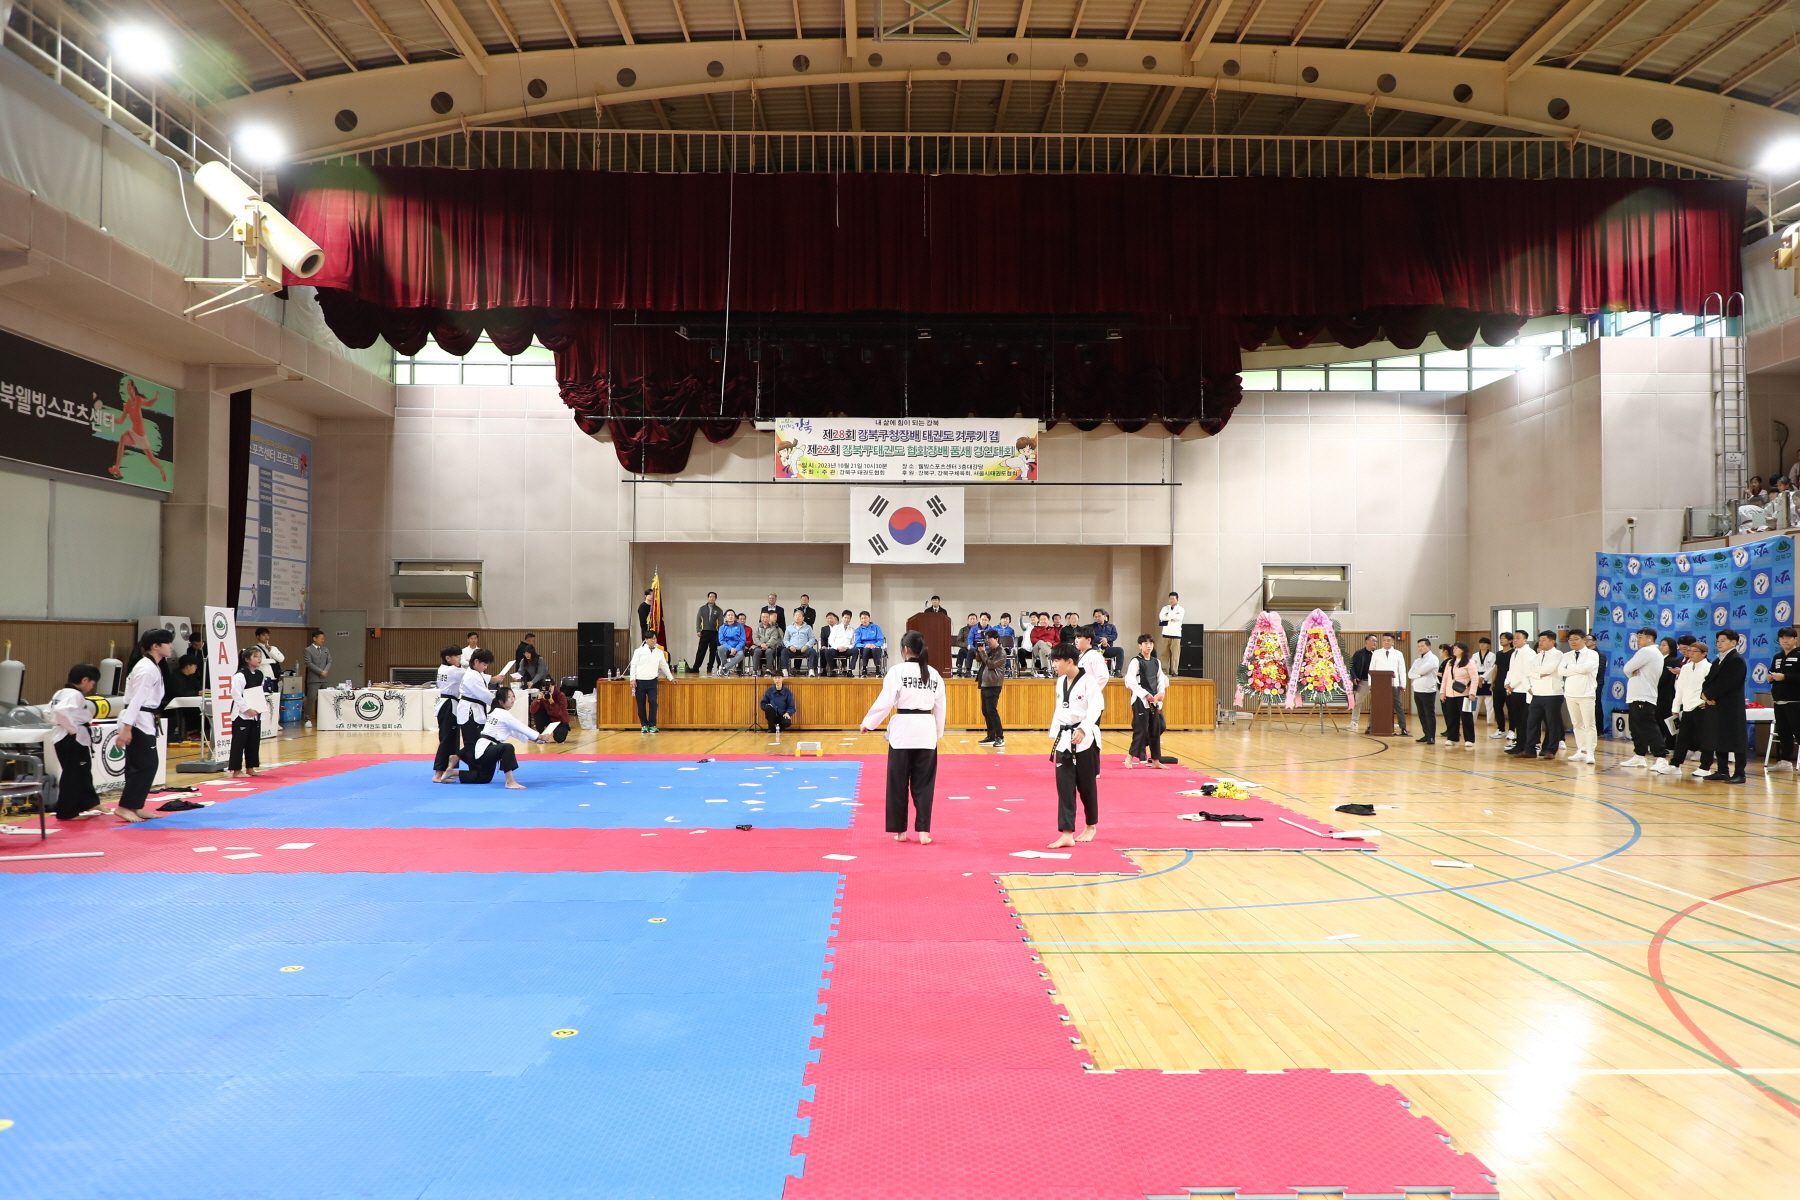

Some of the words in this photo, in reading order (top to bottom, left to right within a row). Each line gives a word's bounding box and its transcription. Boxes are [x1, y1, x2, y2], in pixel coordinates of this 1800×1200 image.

[822, 429, 856, 440] 제28회
[858, 429, 921, 442] 강북구청장배
[922, 430, 954, 443] 태권도
[955, 430, 988, 443] 겨루기
[989, 430, 1000, 443] 겸
[807, 444, 840, 456] 제22회
[842, 445, 905, 457] 강북구태권도
[907, 445, 949, 458] 협회장배
[950, 445, 972, 458] 품새
[973, 446, 1016, 458] 경연대회
[276, 451, 299, 470] 프로그램
[1753, 543, 1769, 557] KTA
[1692, 553, 1708, 564] KTA
[1774, 570, 1791, 584] KTA
[1660, 582, 1673, 594] KTA
[1713, 578, 1728, 591] KTA
[1677, 608, 1689, 621] KTA
[1732, 605, 1747, 618] KTA
[1752, 633, 1768, 647] KTA
[1618, 718, 1623, 730] 2
